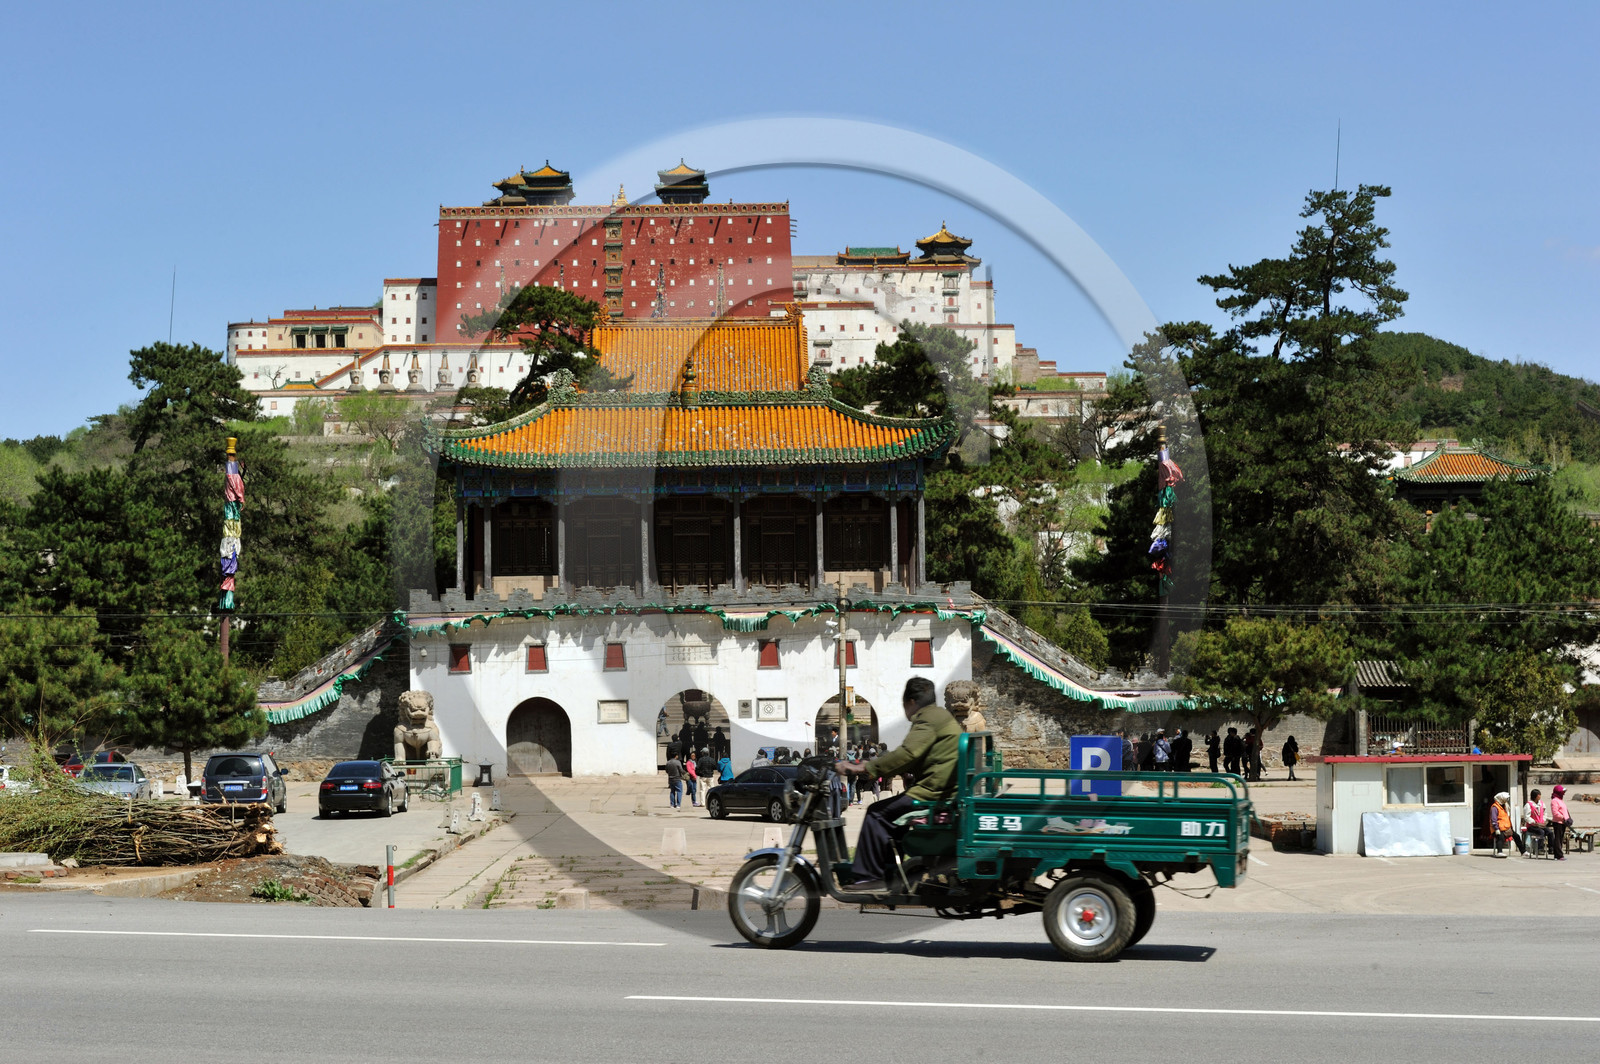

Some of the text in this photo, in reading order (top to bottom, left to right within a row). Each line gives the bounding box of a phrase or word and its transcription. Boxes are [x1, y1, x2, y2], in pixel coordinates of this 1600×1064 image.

[1082, 747, 1111, 792] P
[978, 815, 1225, 837] 金马 助力
